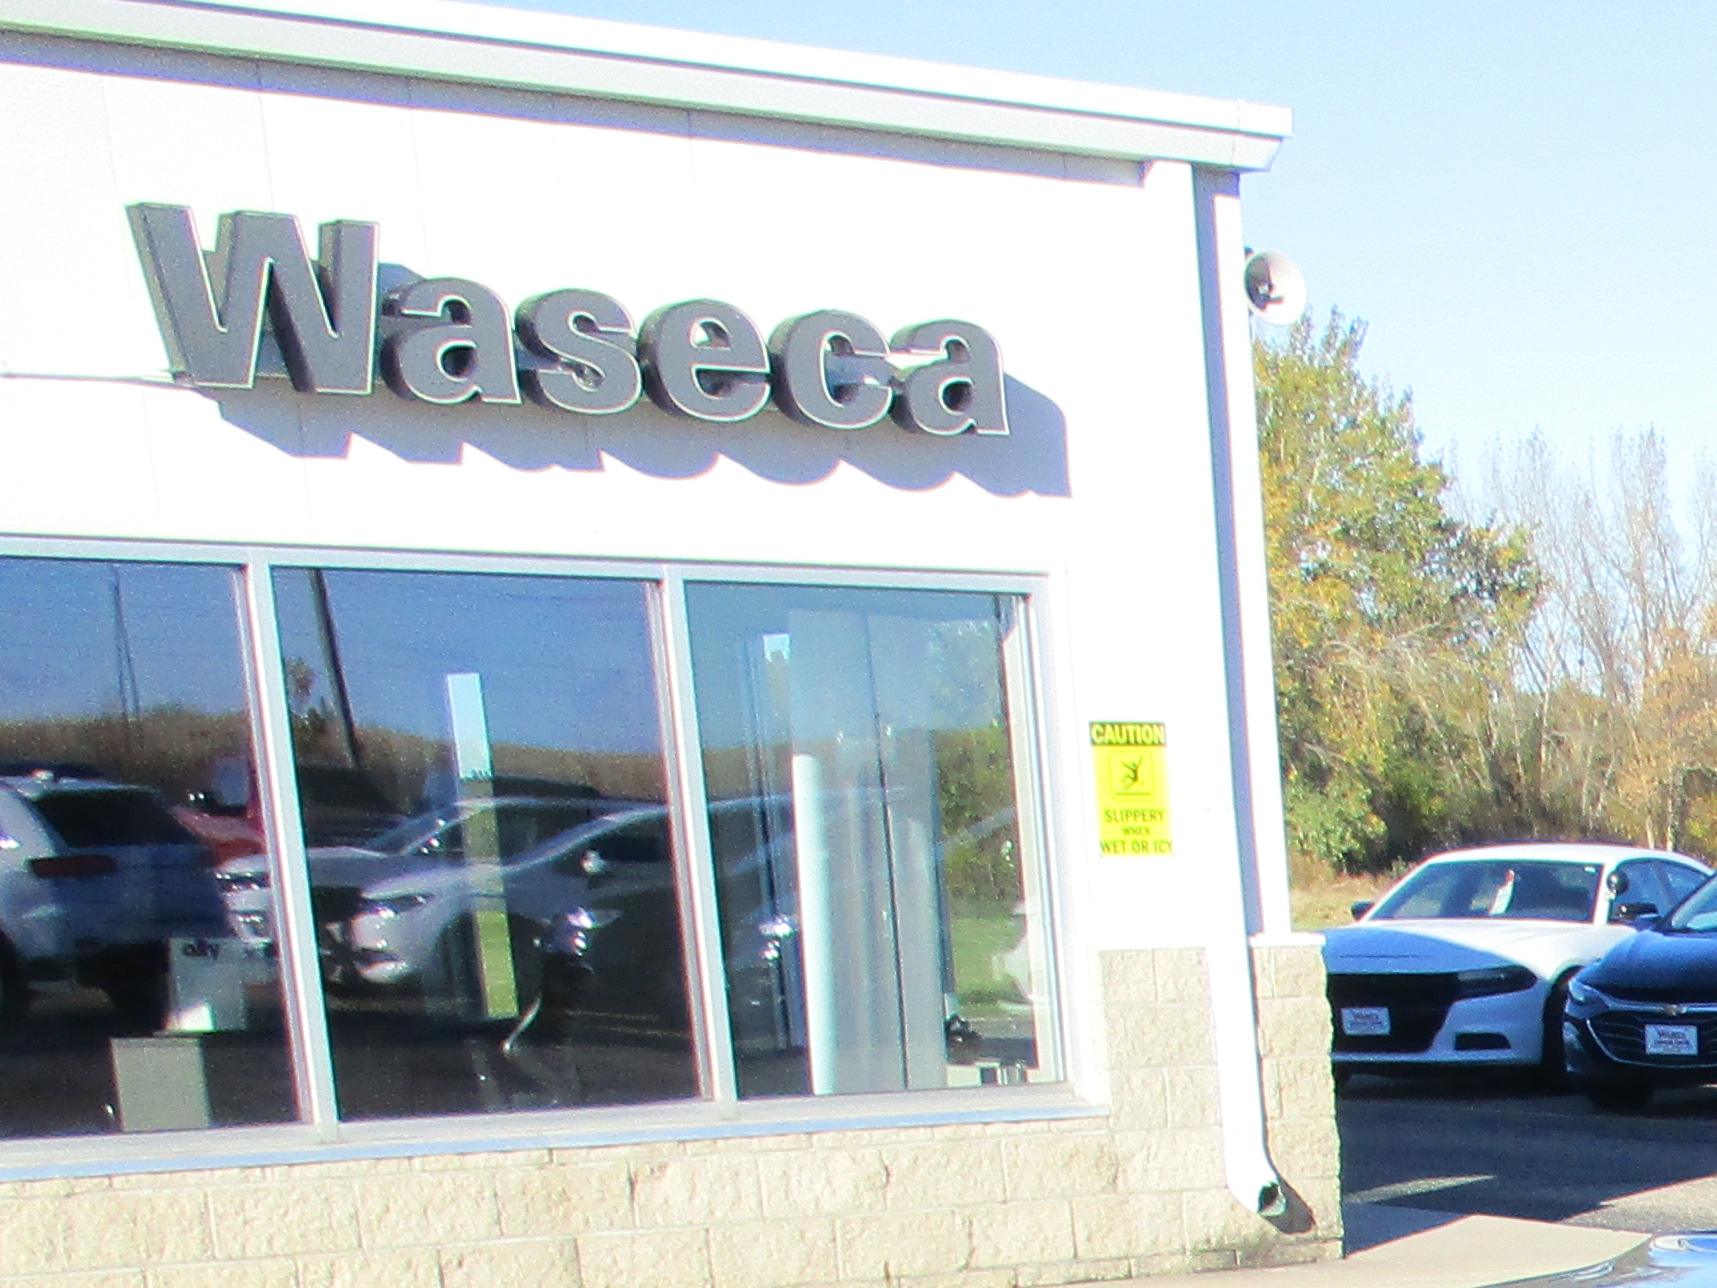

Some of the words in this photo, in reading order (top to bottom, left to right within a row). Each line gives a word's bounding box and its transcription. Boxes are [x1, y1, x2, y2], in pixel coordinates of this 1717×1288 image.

[124, 201, 1012, 438] Waseca
[1091, 723, 1165, 745] CAUTION
[1103, 808, 1166, 823] SLIPPERY
[1121, 825, 1151, 836] WHEN
[1100, 839, 1127, 854] WET
[1131, 840, 1149, 853] OR
[1154, 840, 1173, 854] ICY
